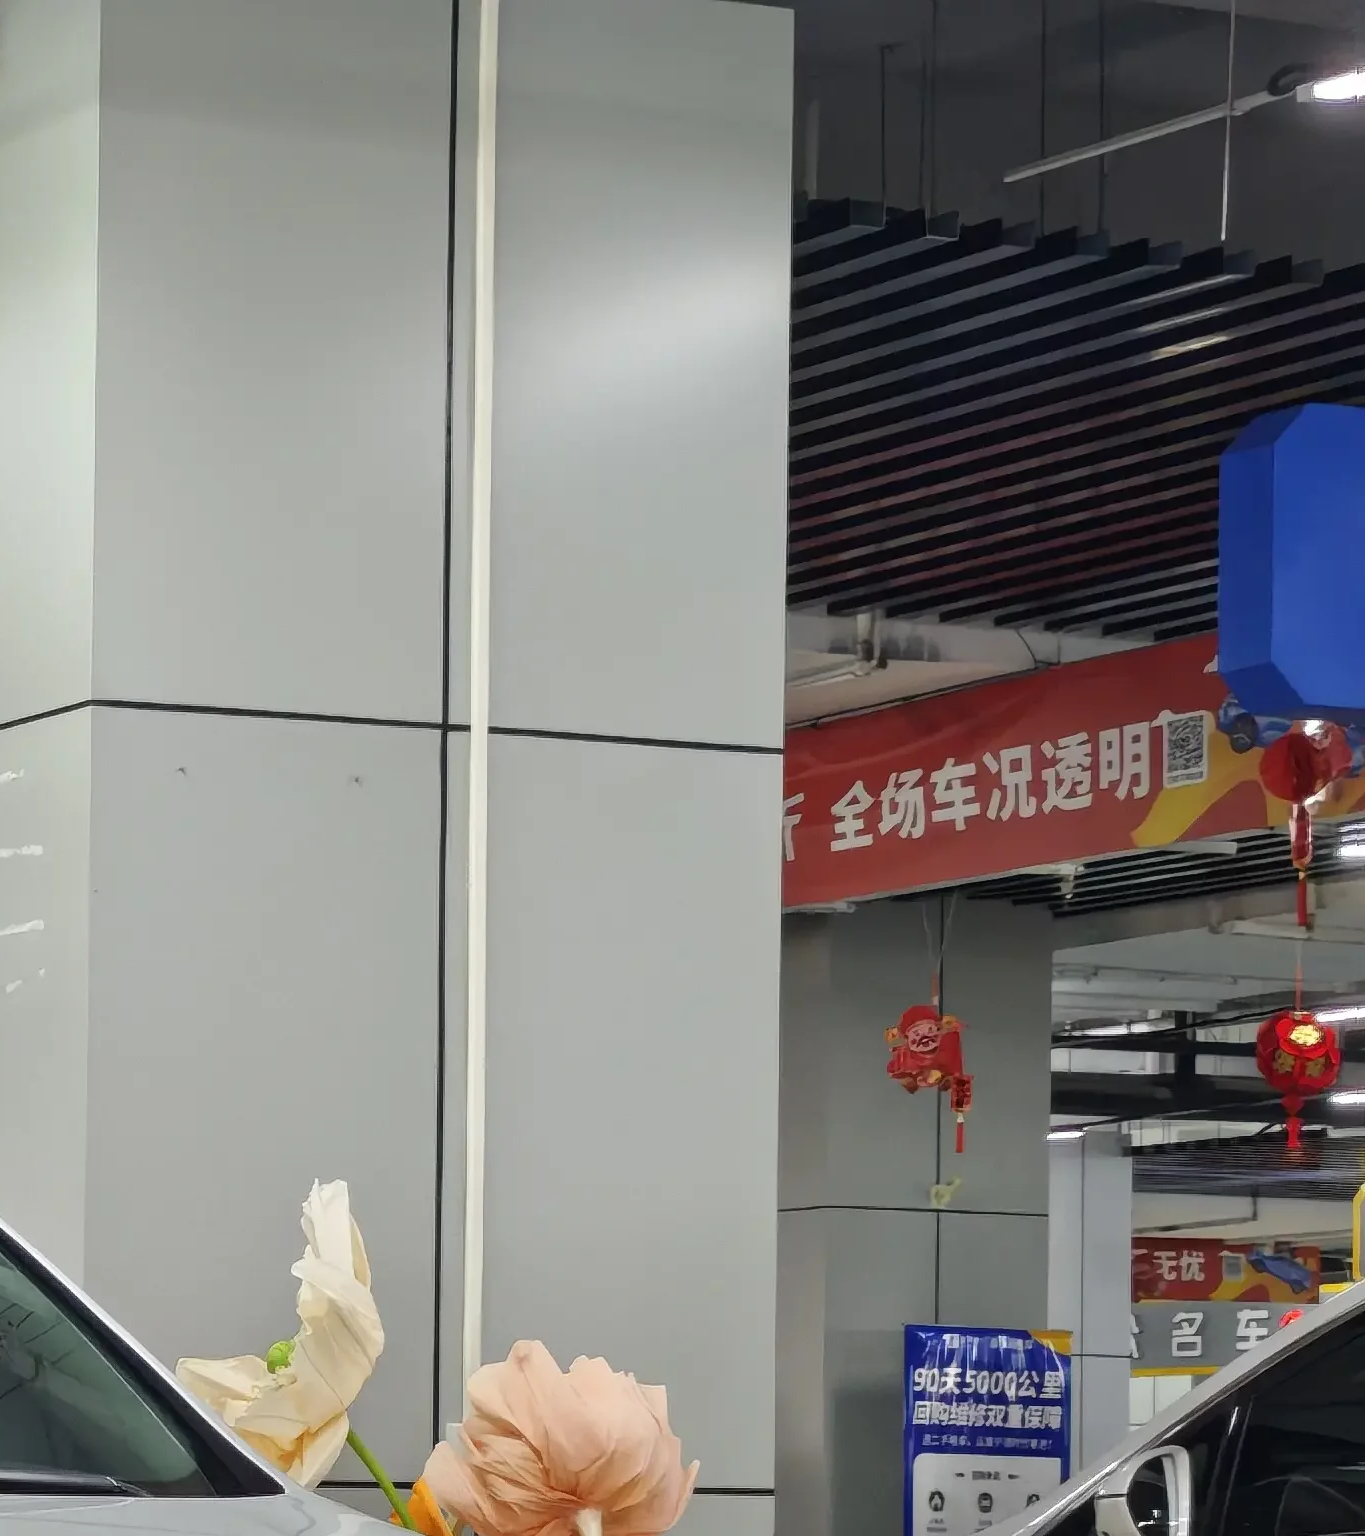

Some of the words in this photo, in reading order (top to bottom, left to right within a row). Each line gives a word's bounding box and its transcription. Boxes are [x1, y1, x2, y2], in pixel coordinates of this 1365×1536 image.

[831, 715, 1152, 852] 全场车况透明
[1153, 1250, 1206, 1282] 无忧
[1130, 1309, 1270, 1359] 名车
[914, 1368, 1063, 1400] 90天5000公里
